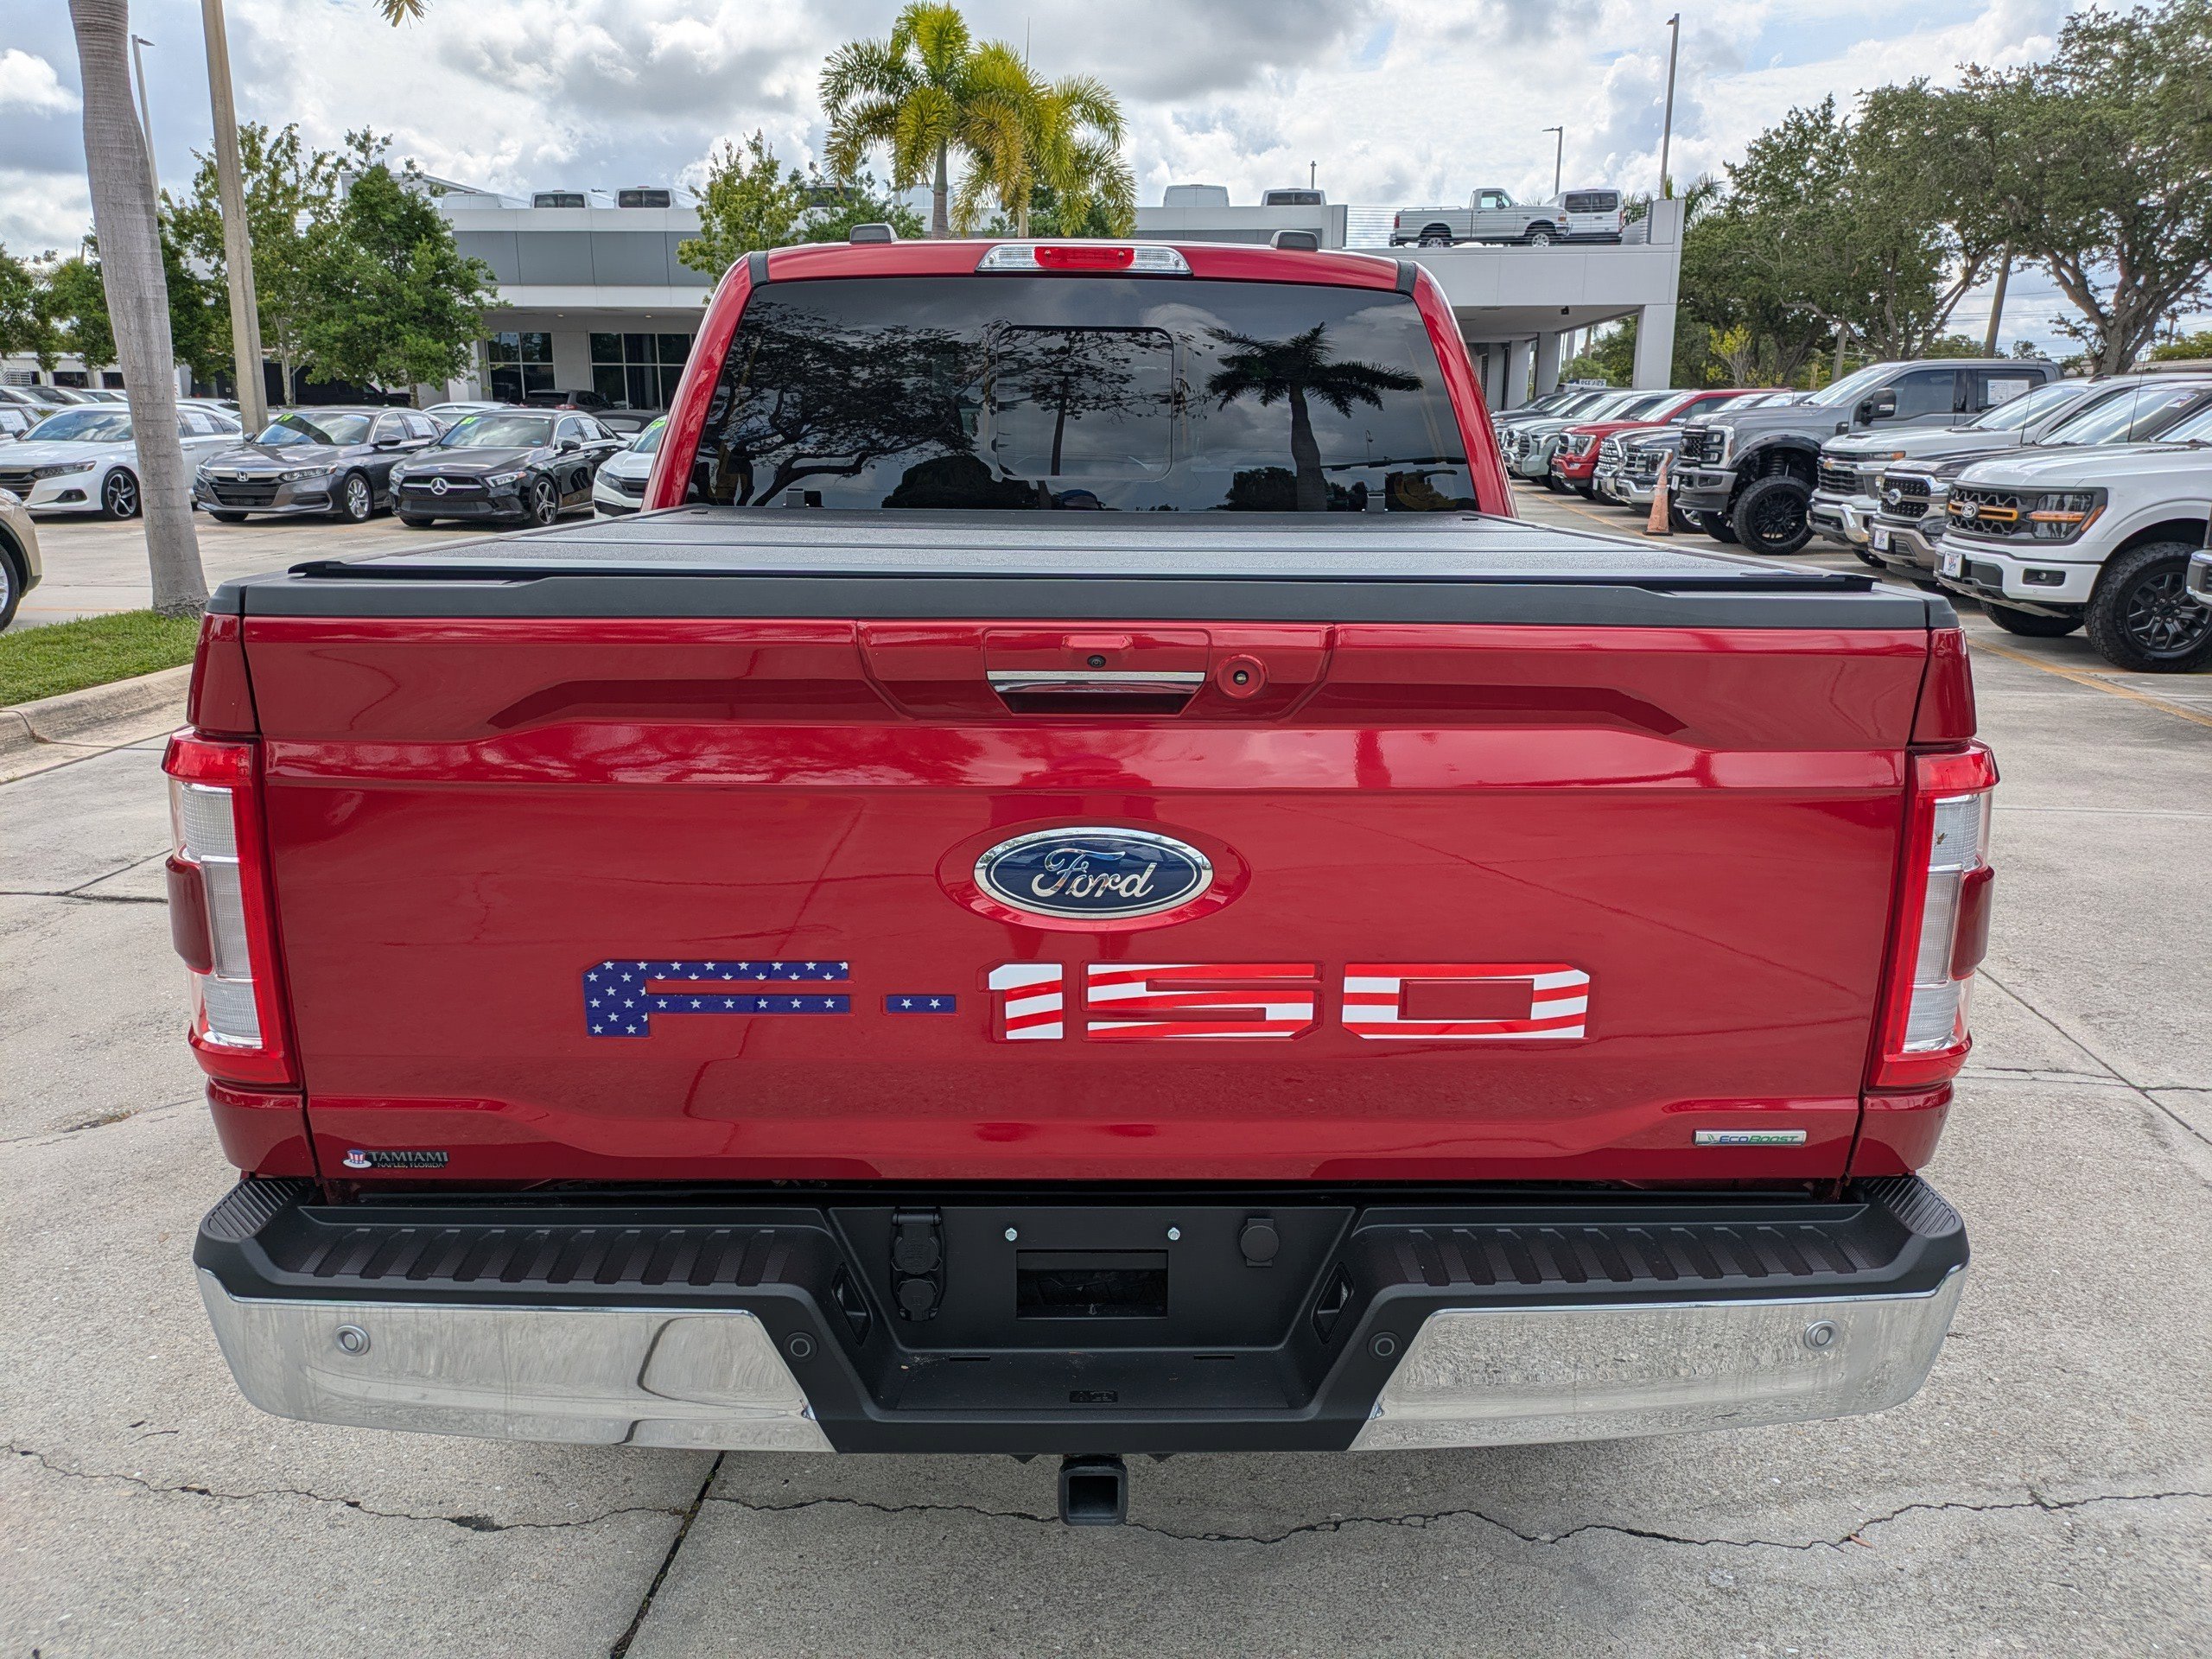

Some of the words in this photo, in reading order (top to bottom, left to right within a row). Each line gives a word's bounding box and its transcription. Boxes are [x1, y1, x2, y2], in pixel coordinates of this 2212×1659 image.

[1031, 847, 1158, 899] Ford
[582, 961, 1591, 1039] F-150
[368, 1151, 448, 1162] TAMIAMI
